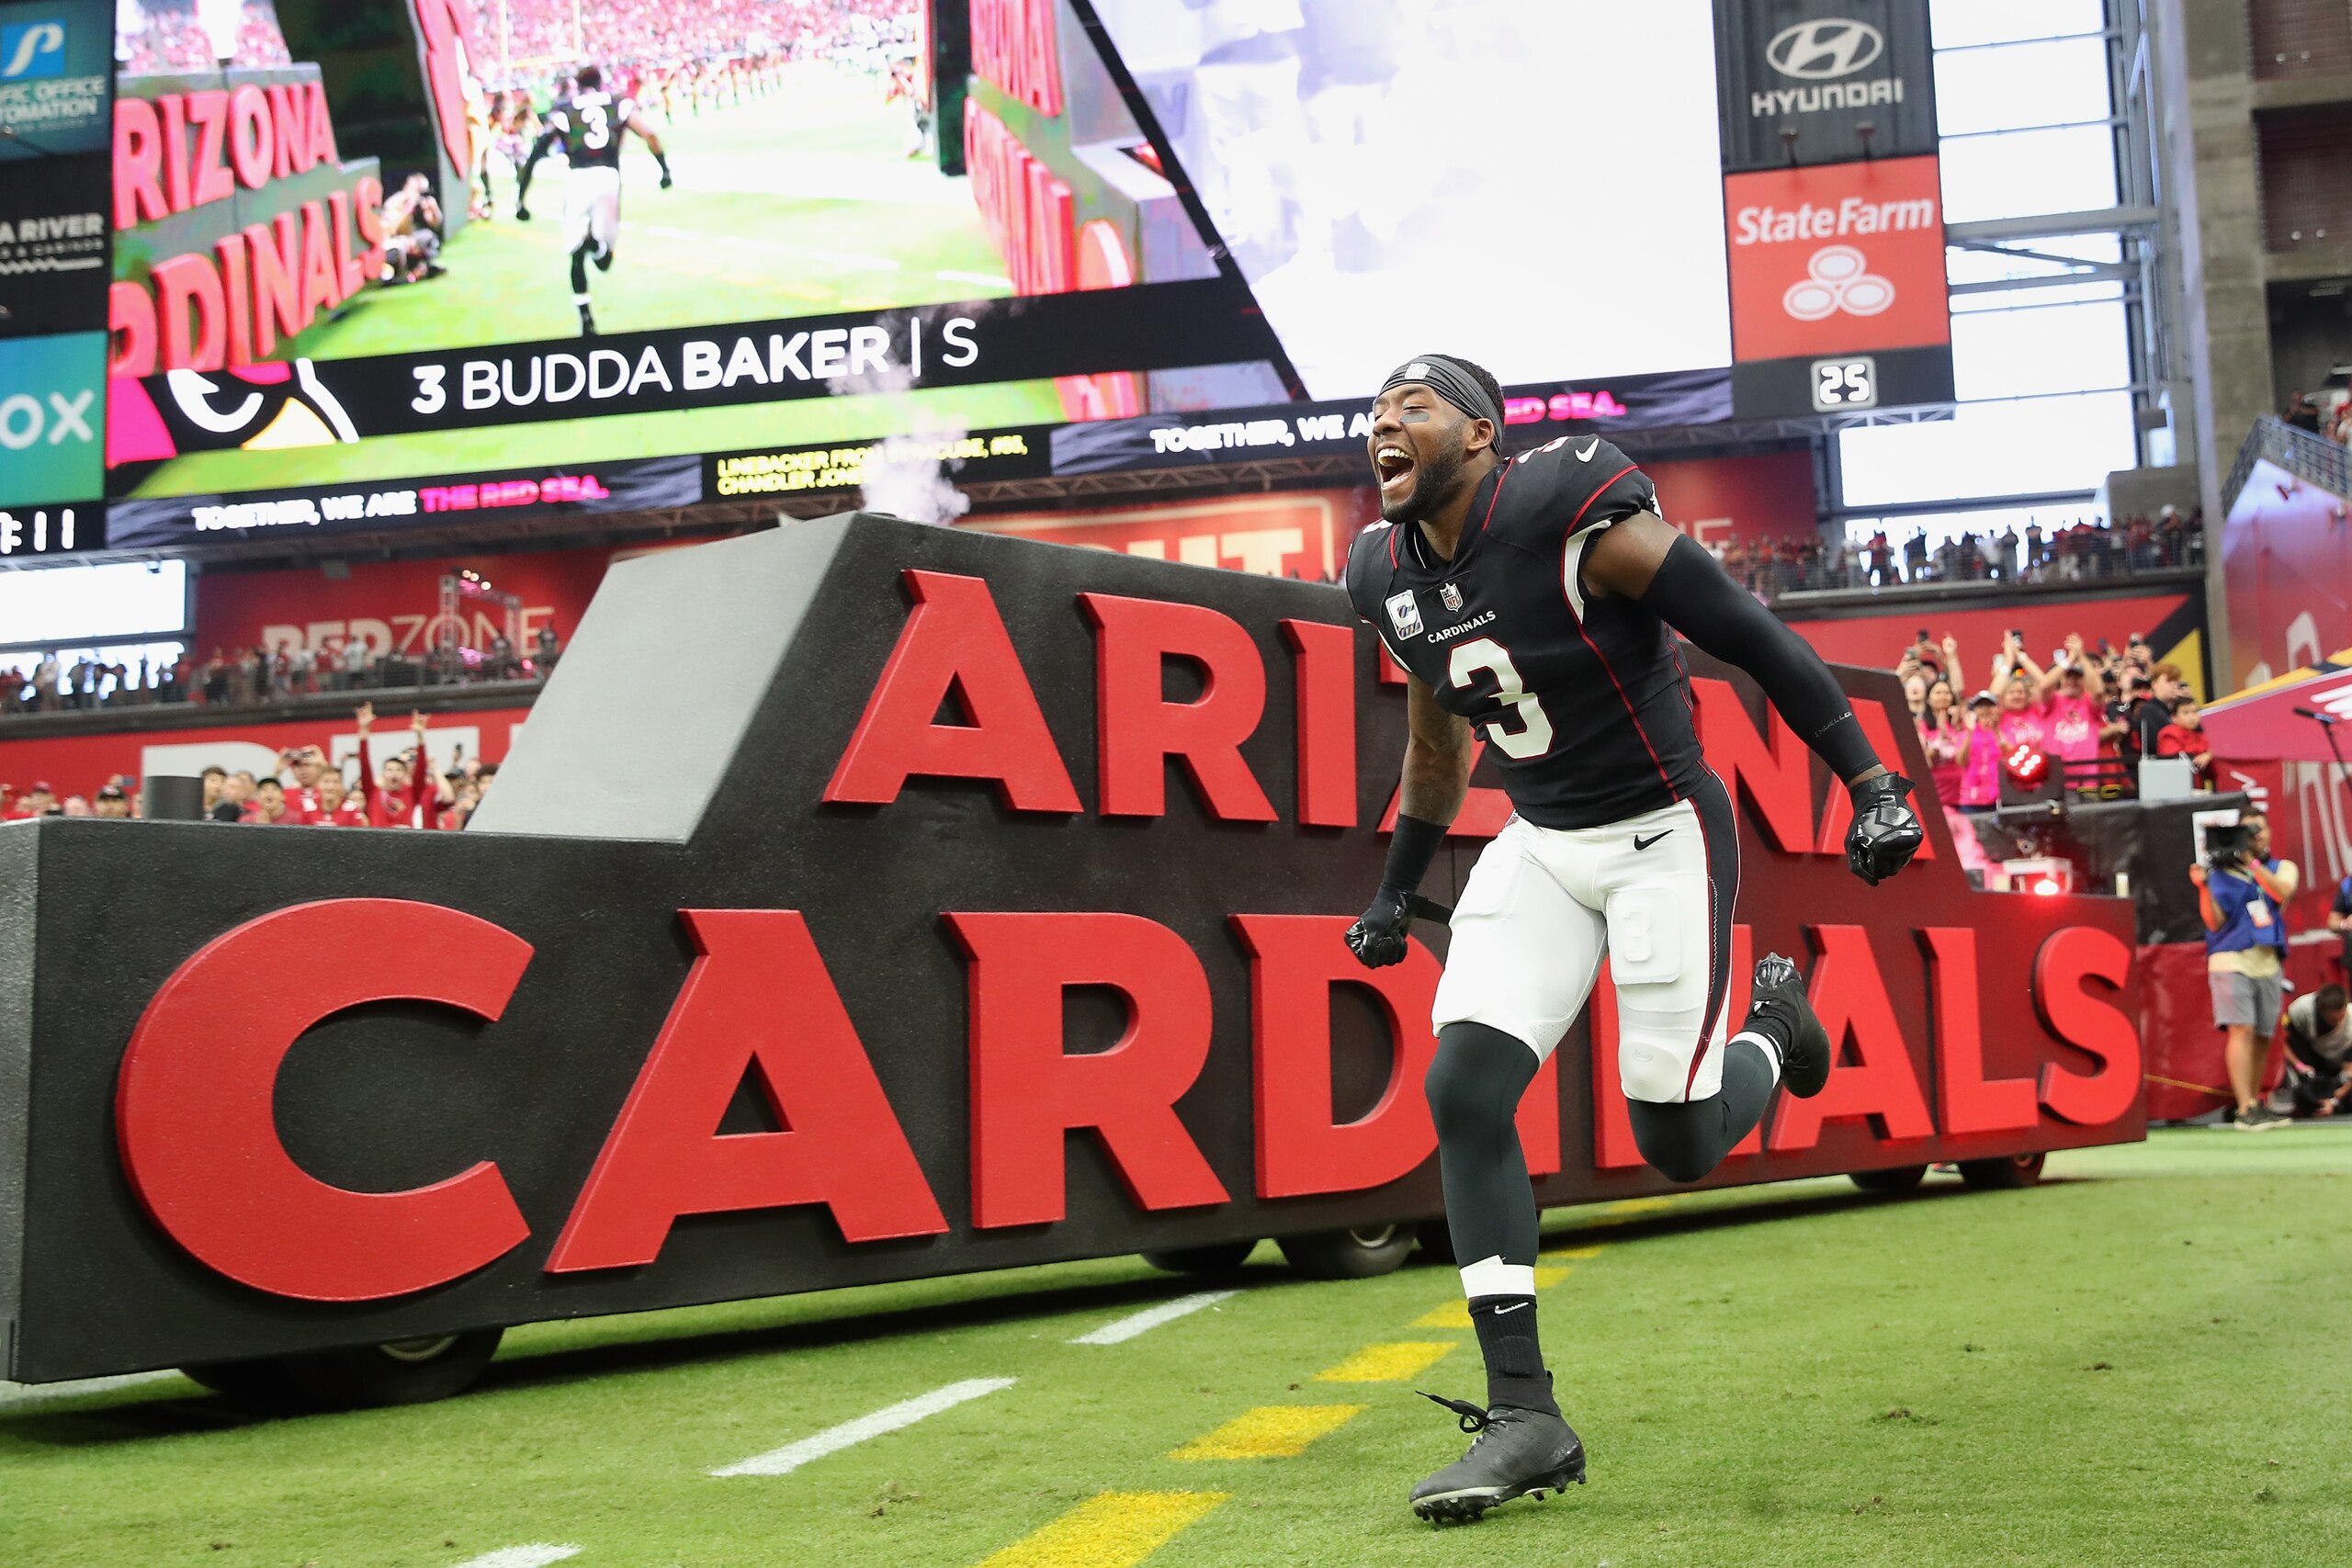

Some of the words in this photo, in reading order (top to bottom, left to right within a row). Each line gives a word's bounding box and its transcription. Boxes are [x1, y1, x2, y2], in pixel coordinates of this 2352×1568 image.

[1751, 77, 1905, 118] HYUNDAI
[18, 212, 104, 243] RIVER
[411, 365, 447, 414] 3
[462, 345, 673, 410] BUDDA
[683, 326, 891, 390] BAKER
[942, 317, 979, 367] S
[1818, 363, 1871, 405] 25
[1149, 418, 1295, 454] TOGETHER,
[1296, 413, 1347, 442] WE
[717, 451, 830, 479] LINEBACKER
[717, 470, 816, 497] CHANDLER
[321, 493, 366, 522] WE
[365, 491, 418, 518] ARE
[419, 484, 480, 513] THE
[1427, 610, 1497, 644] CARDINALS
[1448, 636, 1556, 761] 3
